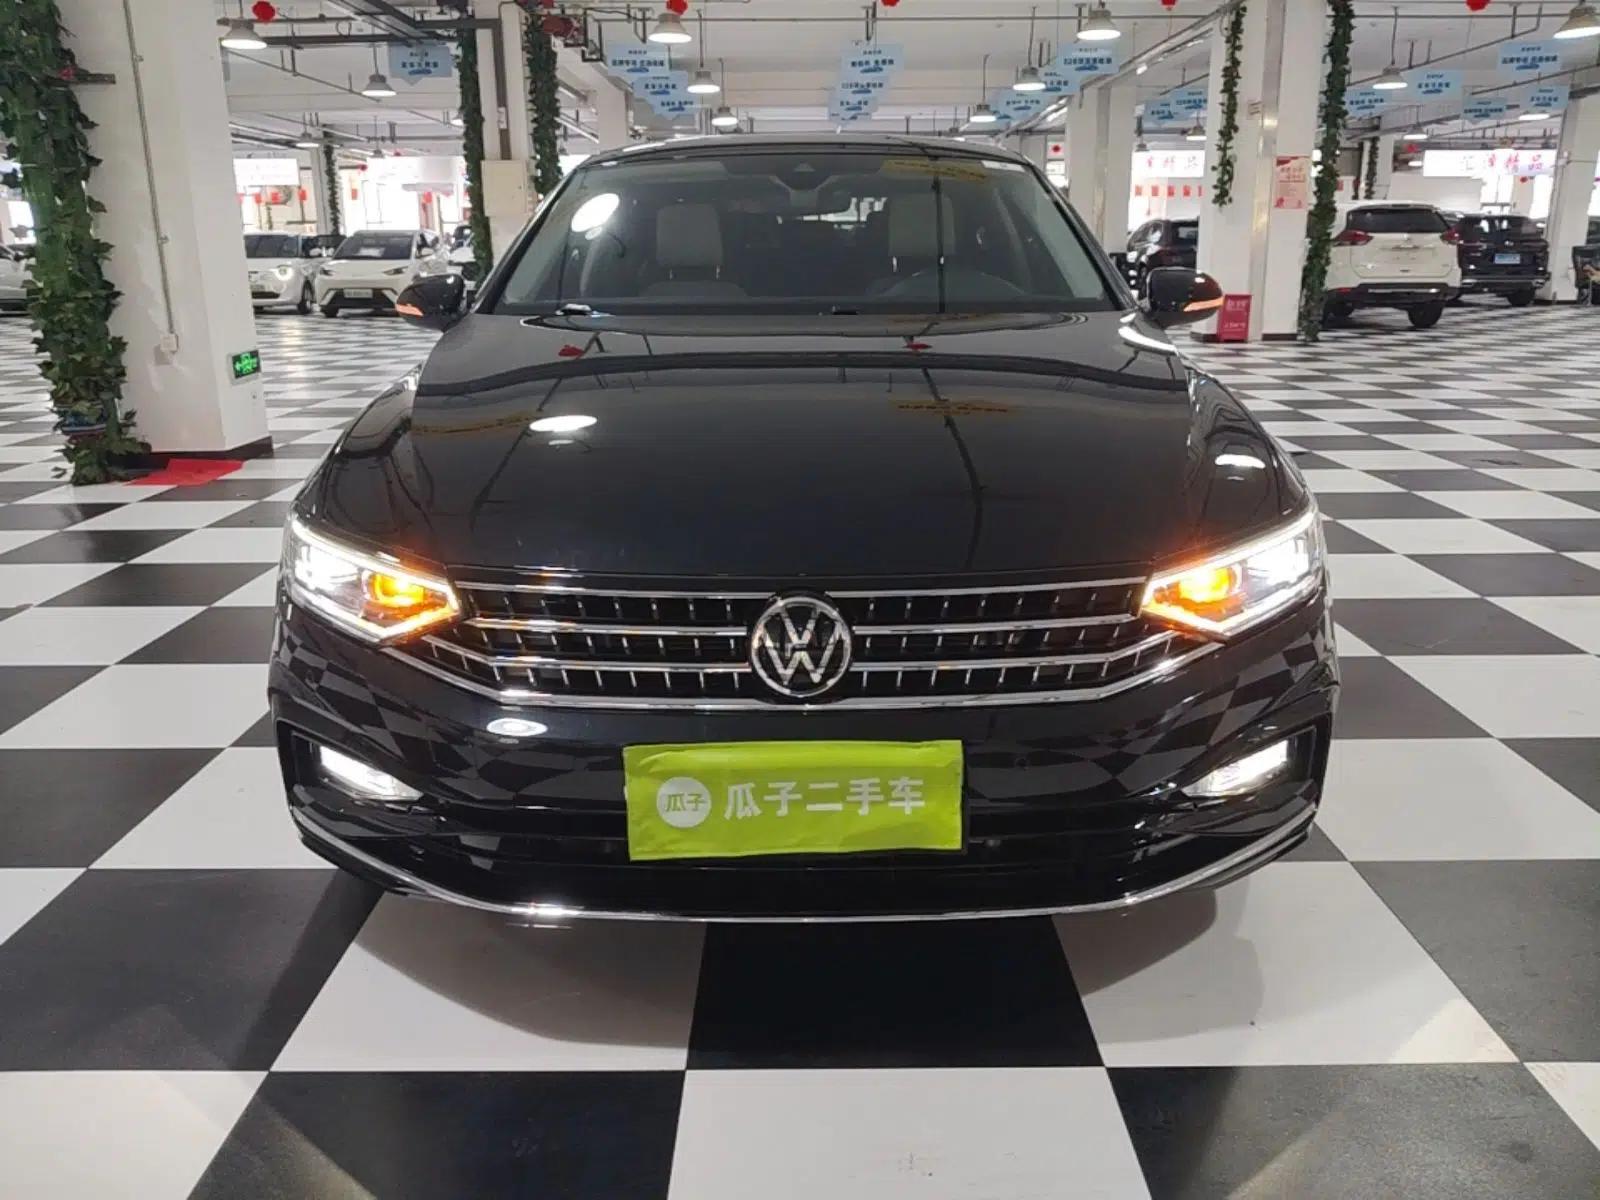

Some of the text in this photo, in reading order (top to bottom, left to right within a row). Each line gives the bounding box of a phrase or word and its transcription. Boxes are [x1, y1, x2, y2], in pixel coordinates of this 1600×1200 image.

[664, 792, 705, 812] 瓜子
[724, 776, 925, 820] 瓜子二手车
